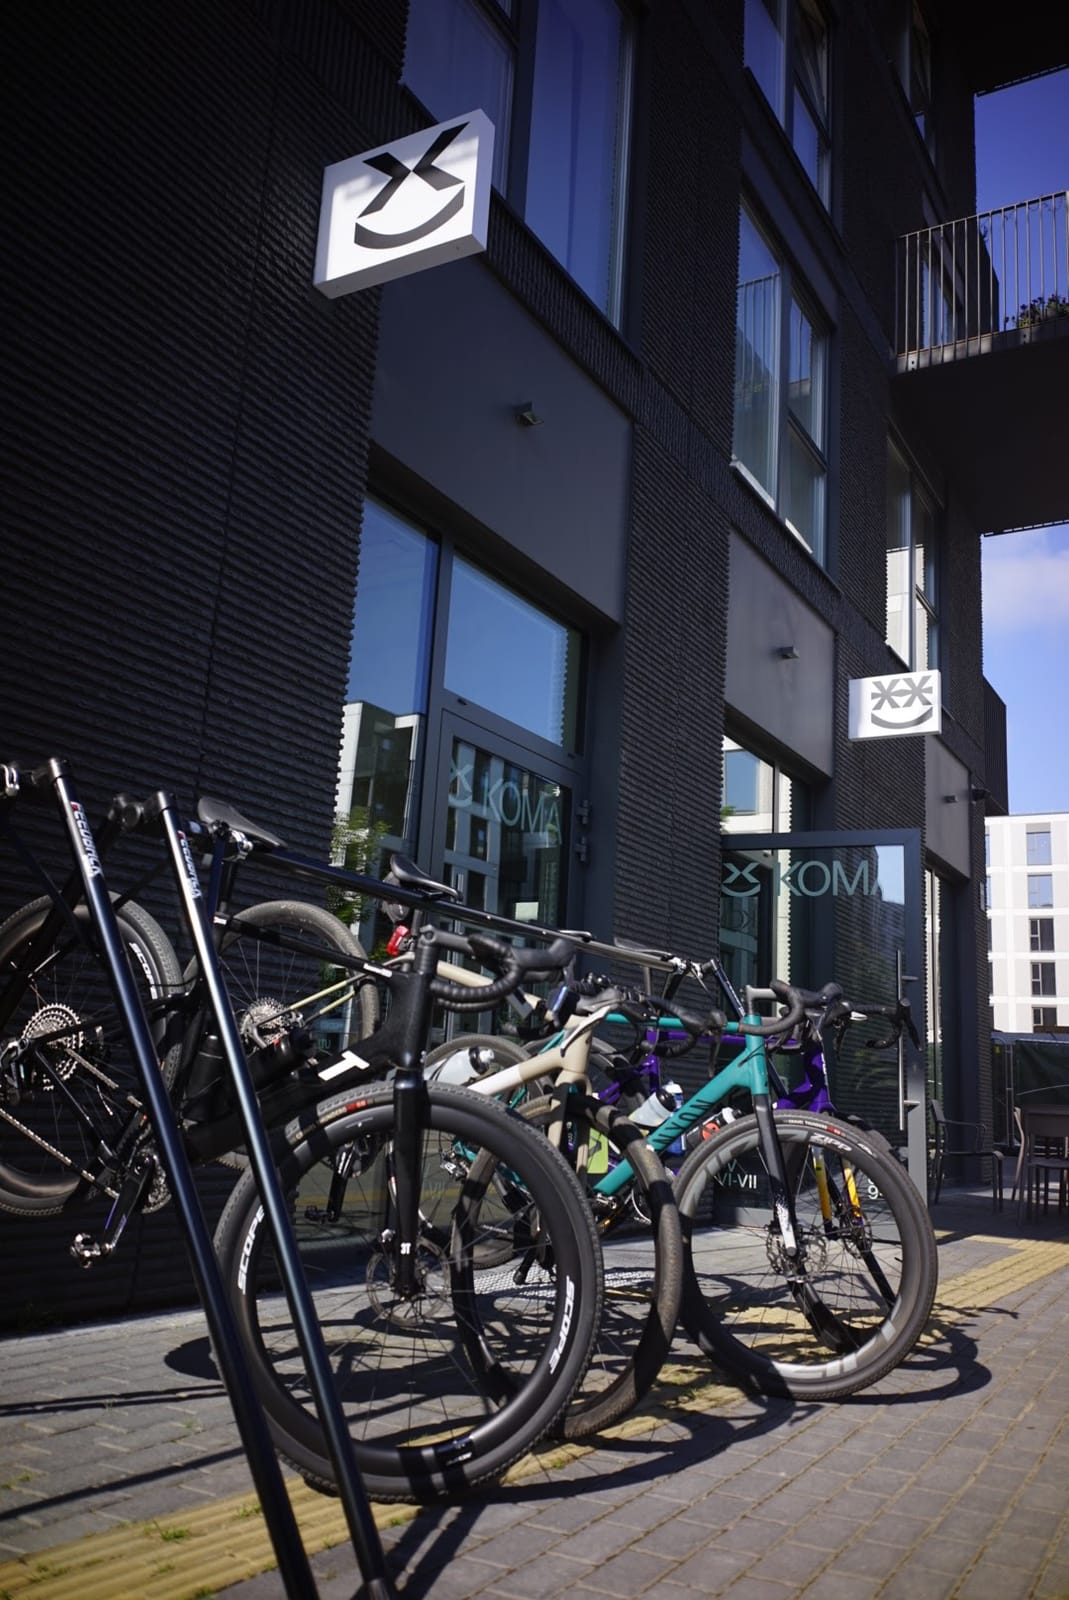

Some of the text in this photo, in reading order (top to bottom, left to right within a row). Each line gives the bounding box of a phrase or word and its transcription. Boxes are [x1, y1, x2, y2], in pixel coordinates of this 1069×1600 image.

[483, 772, 562, 845] KOMA
[237, 1204, 266, 1295] SCOPE
[549, 1274, 575, 1375] SCOPE
